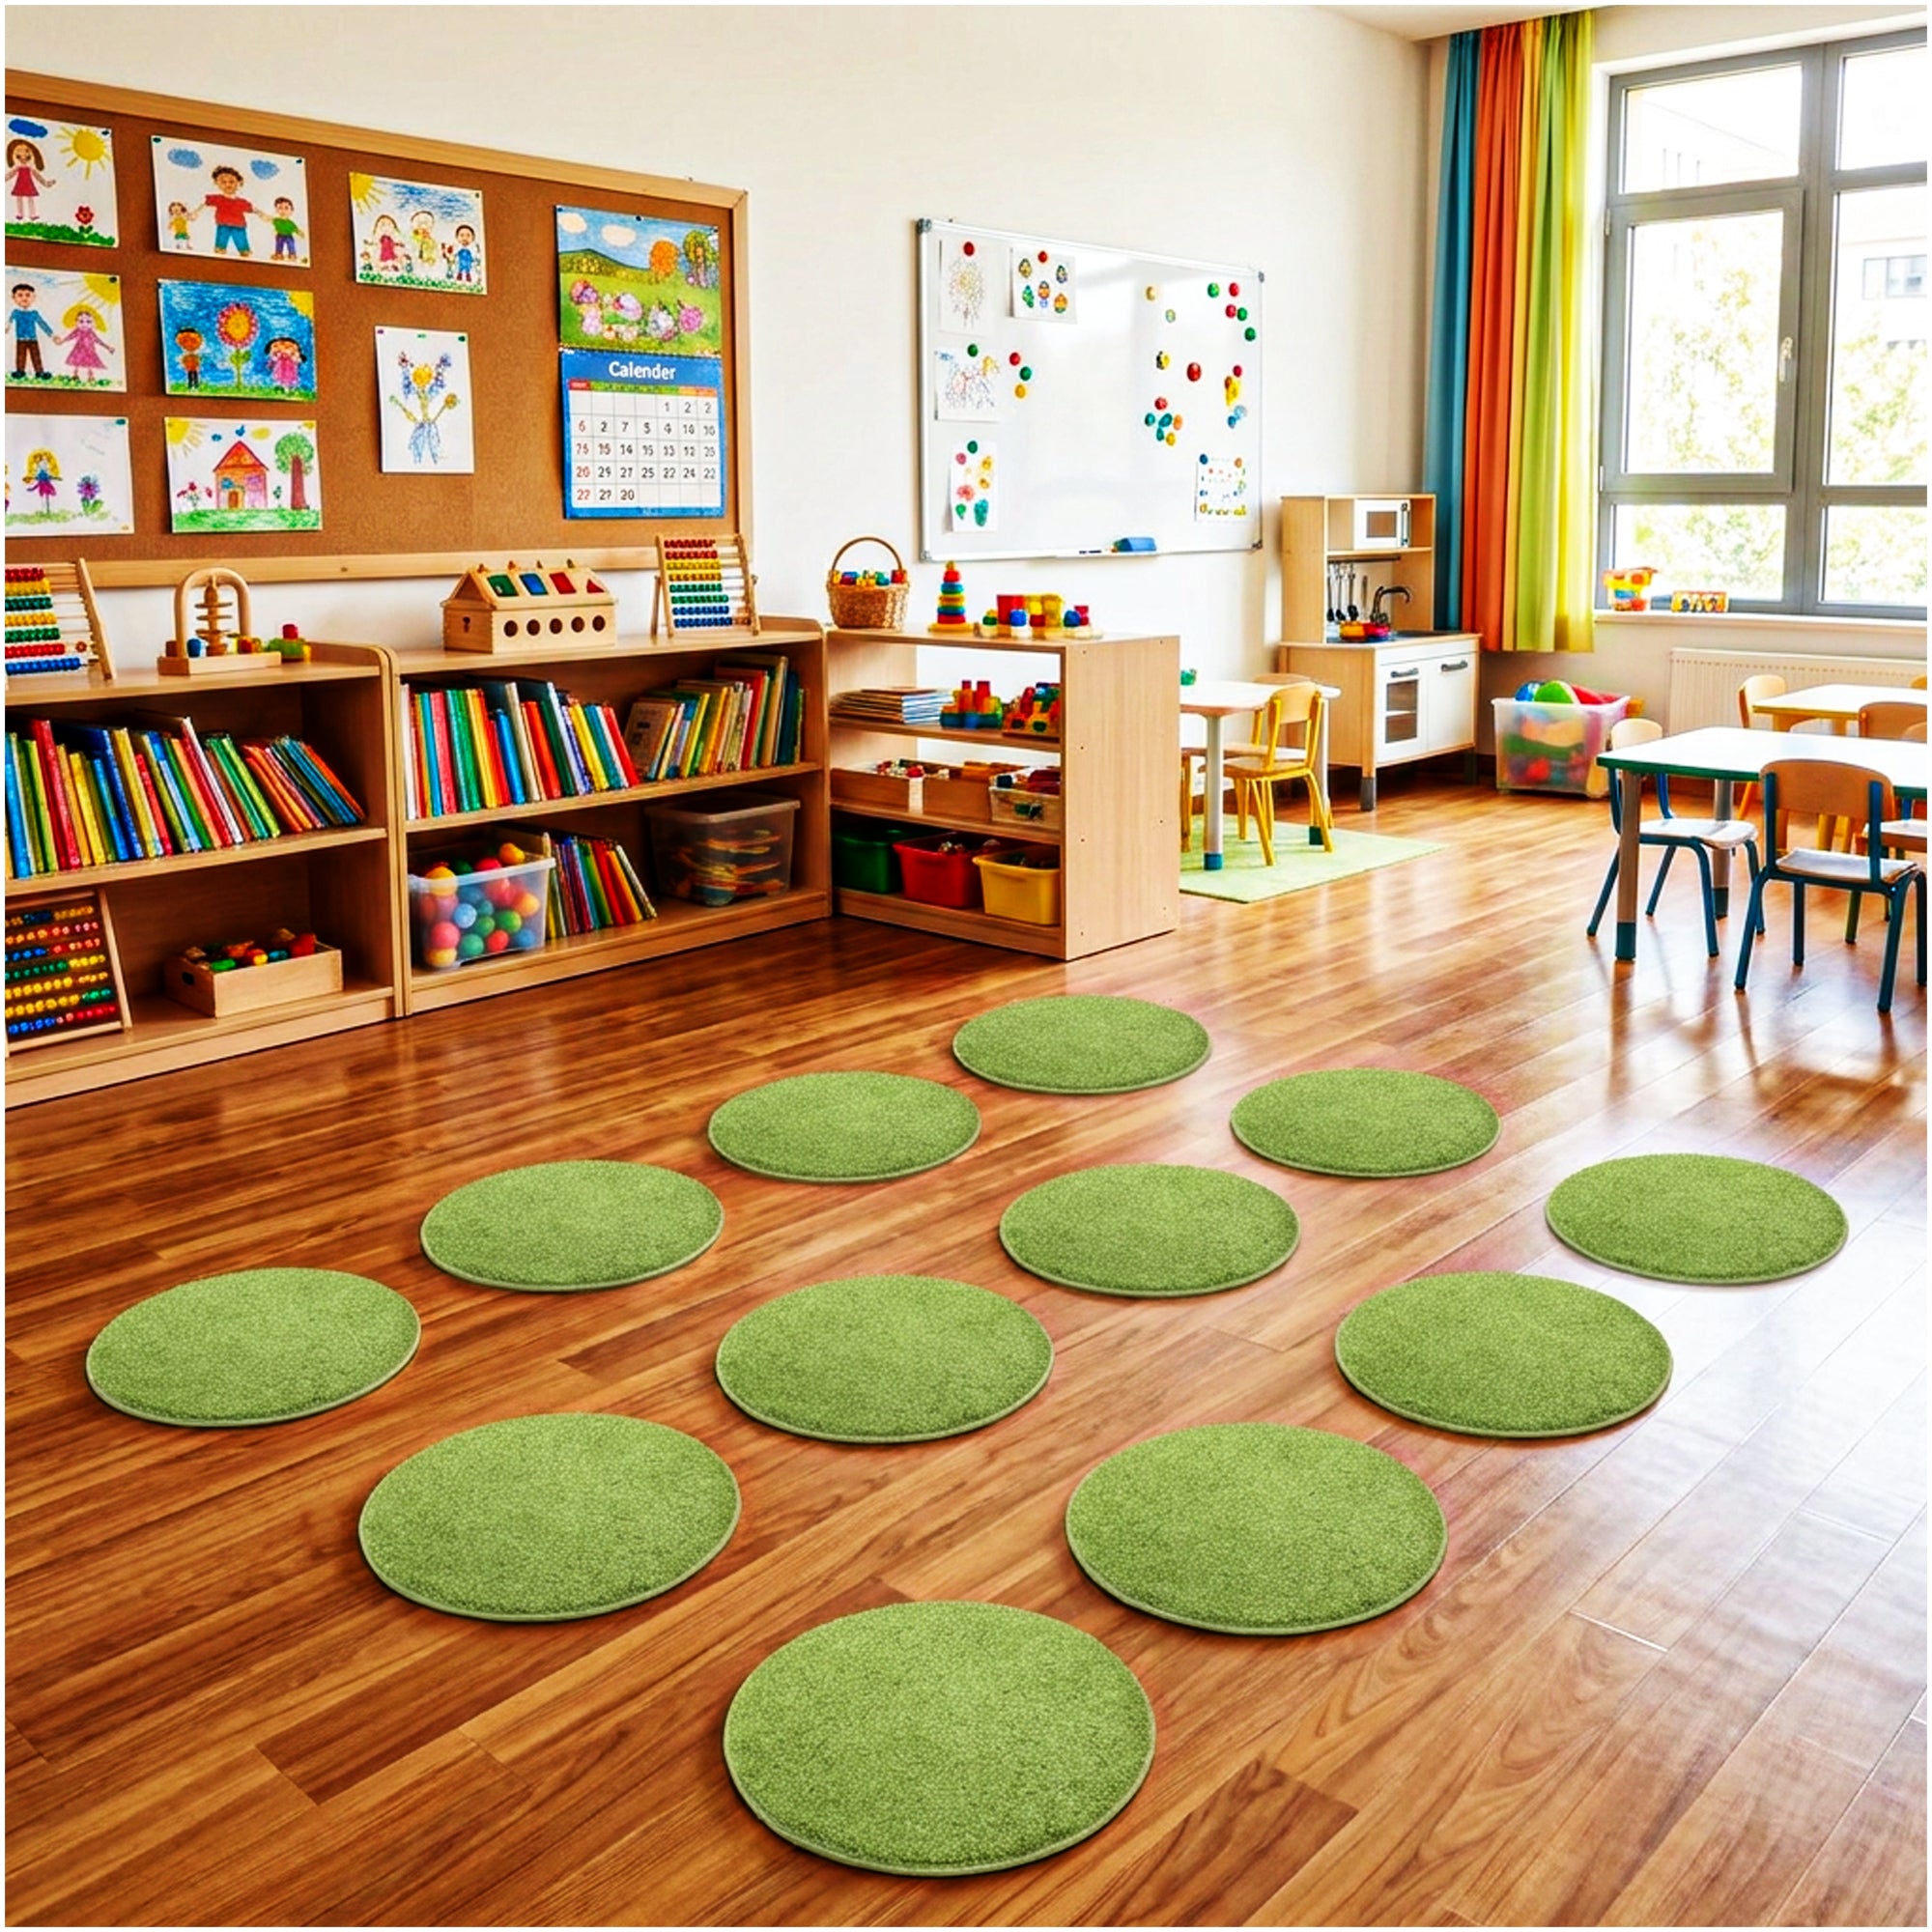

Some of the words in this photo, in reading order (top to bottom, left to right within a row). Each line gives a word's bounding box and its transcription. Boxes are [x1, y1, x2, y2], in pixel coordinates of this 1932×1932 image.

[609, 361, 676, 380] Calender
[665, 402, 669, 412] 1
[685, 402, 691, 412] 2
[705, 402, 711, 413] 2
[622, 422, 629, 432] 7
